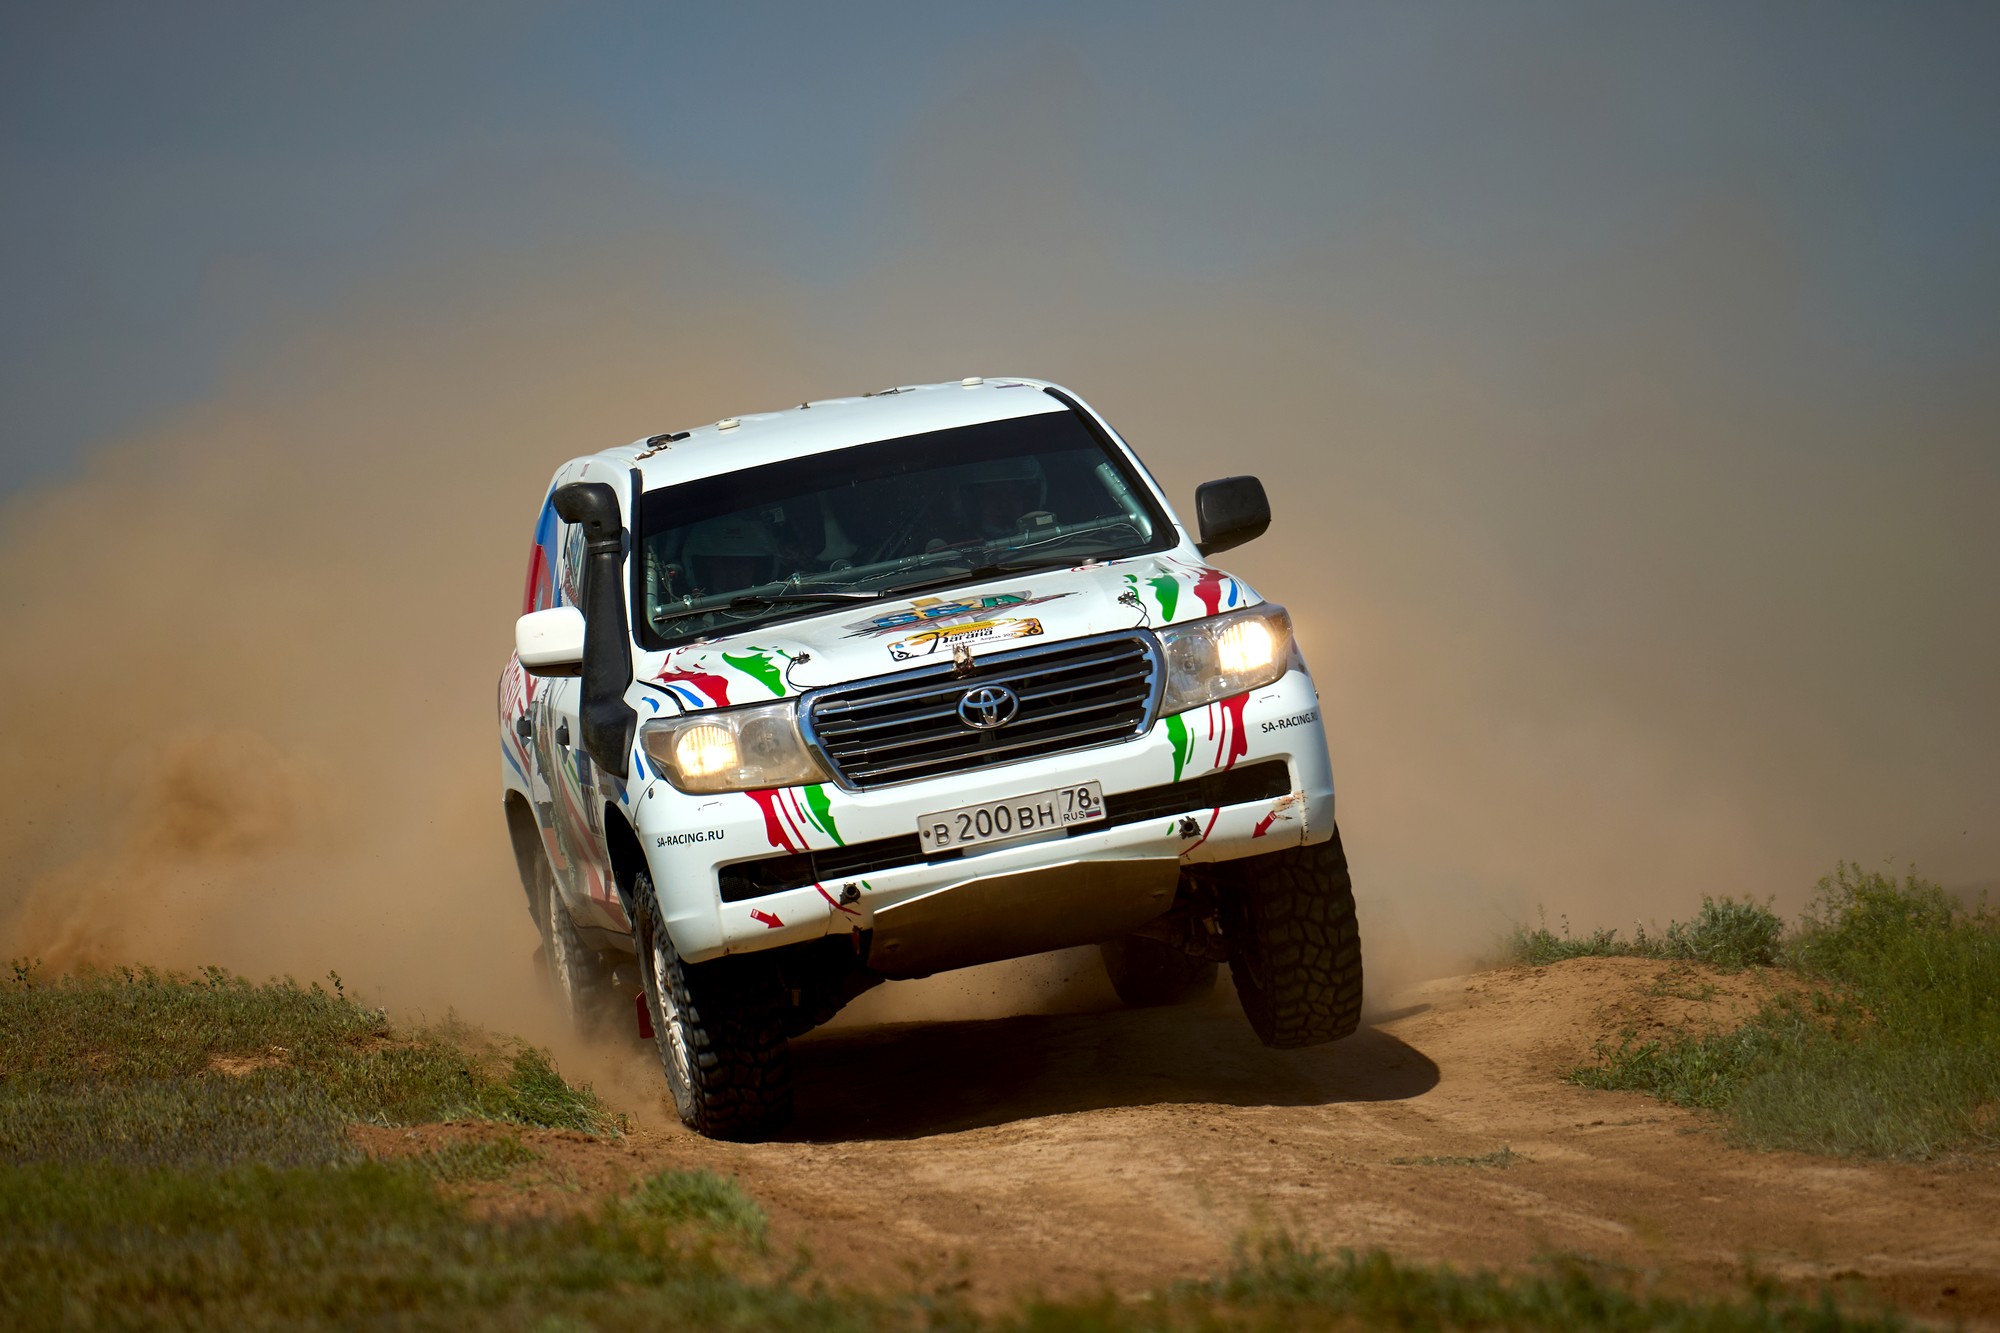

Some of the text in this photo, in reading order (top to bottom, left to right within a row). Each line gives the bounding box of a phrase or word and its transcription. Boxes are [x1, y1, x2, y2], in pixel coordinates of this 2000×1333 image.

[1061, 787, 1092, 812] 78
[1063, 810, 1086, 822] RUS
[656, 829, 724, 848] SA-RACING.RU
